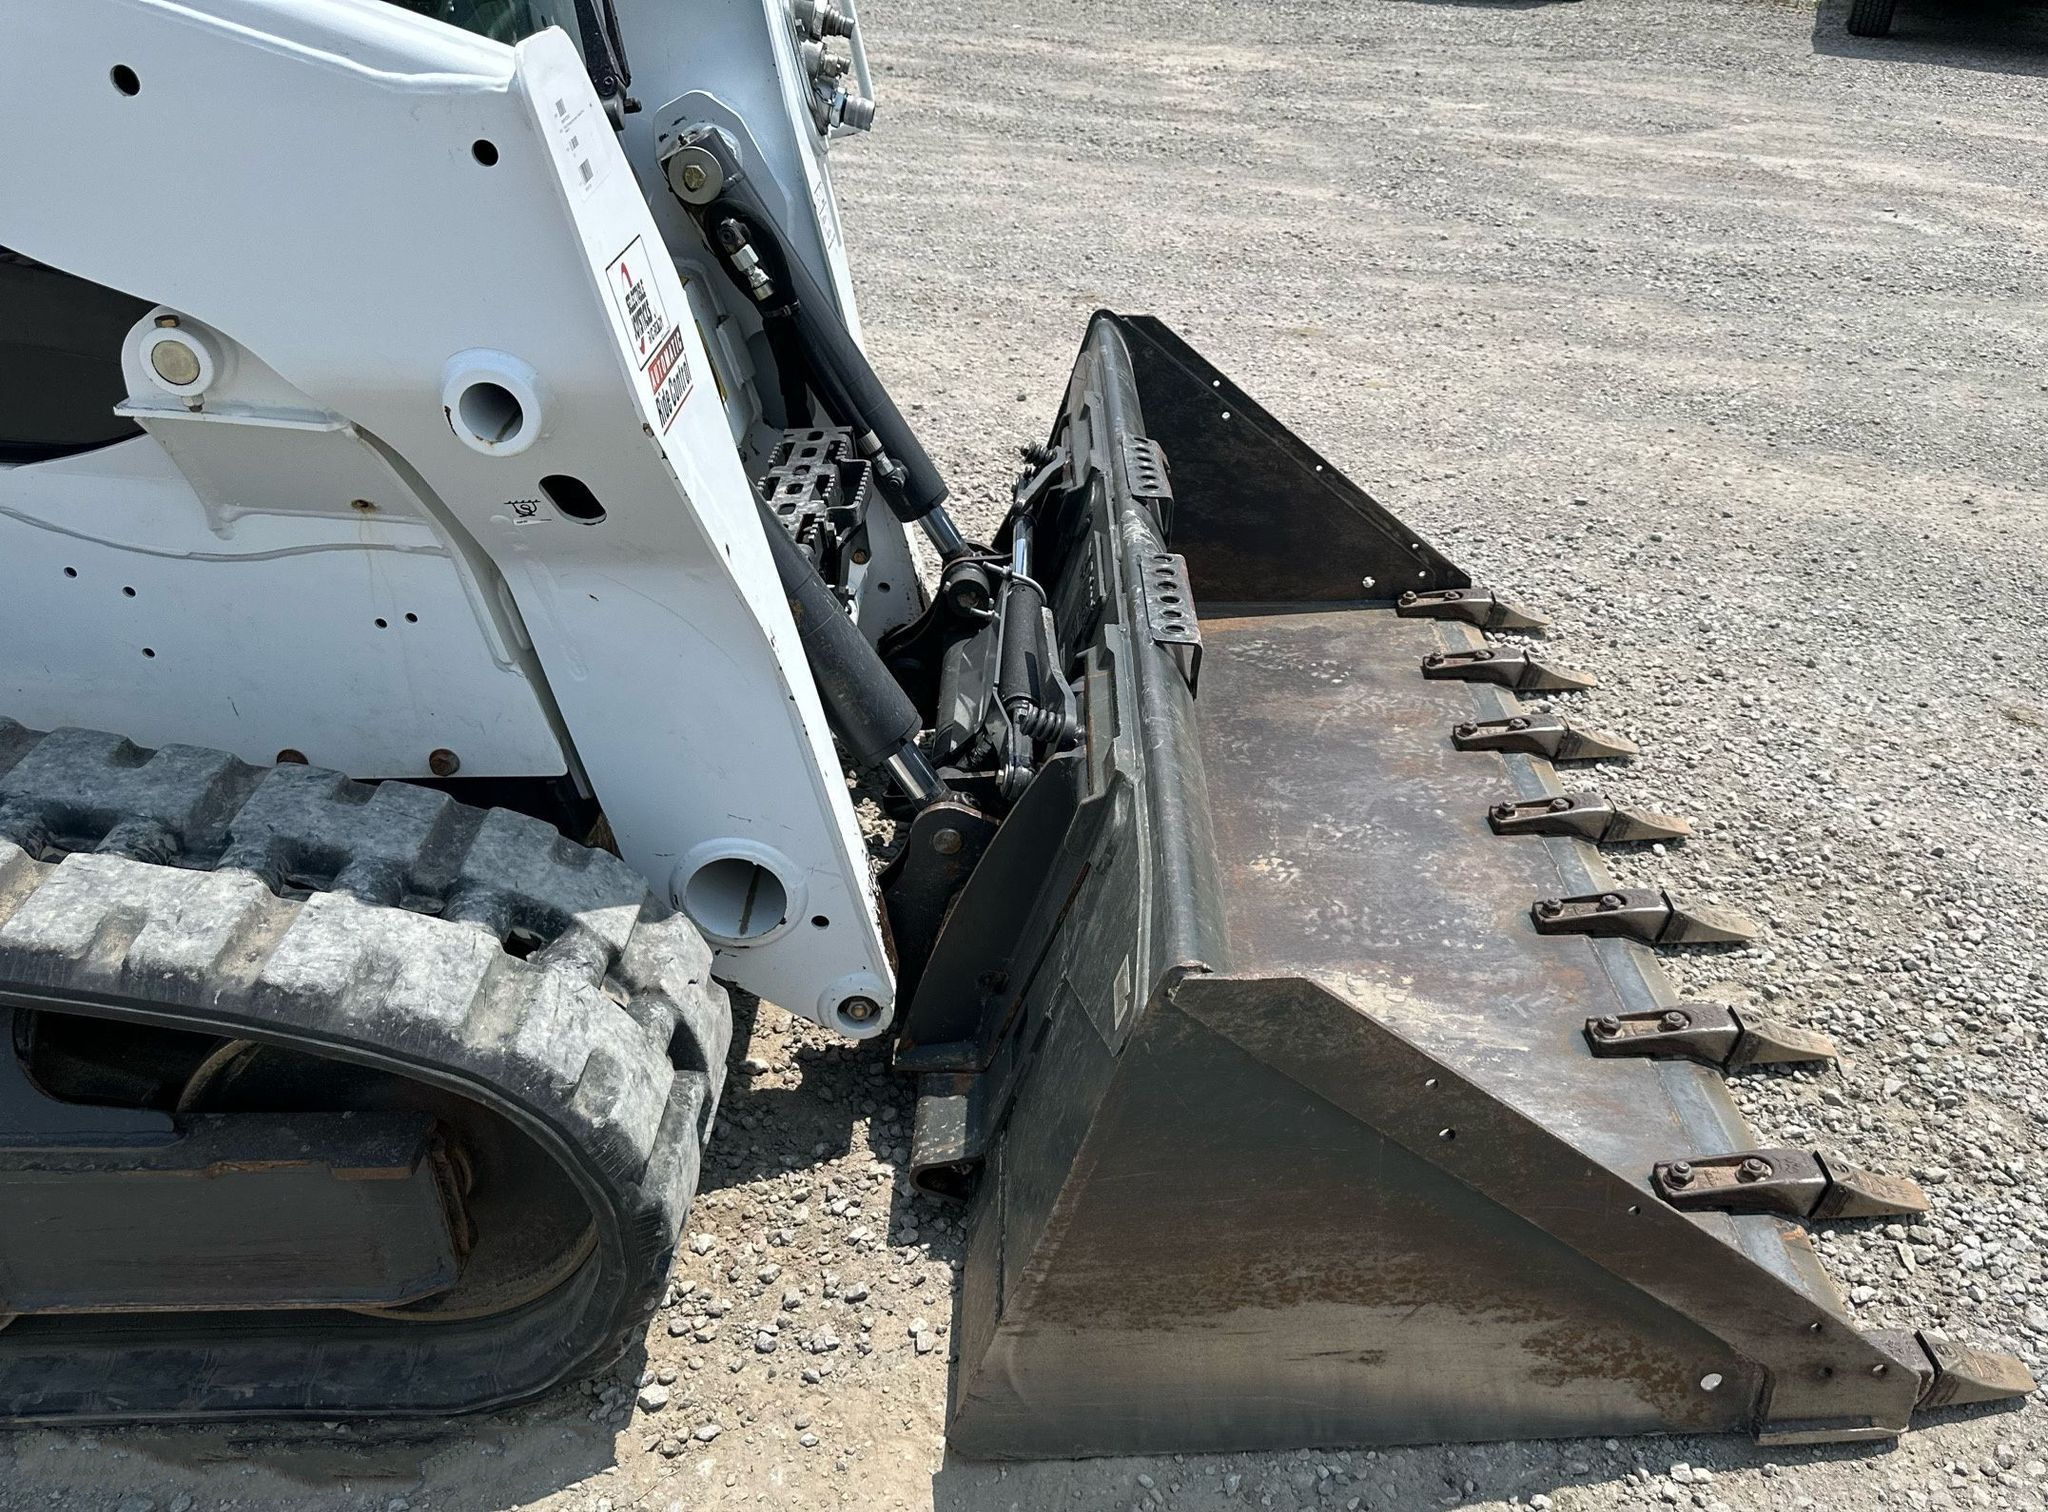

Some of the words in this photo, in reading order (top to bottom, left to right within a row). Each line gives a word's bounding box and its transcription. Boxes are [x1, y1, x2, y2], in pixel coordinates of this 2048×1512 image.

[649, 329, 683, 392] AUTOMATIC
[656, 387, 673, 429] Ride
[668, 353, 693, 407] Control
